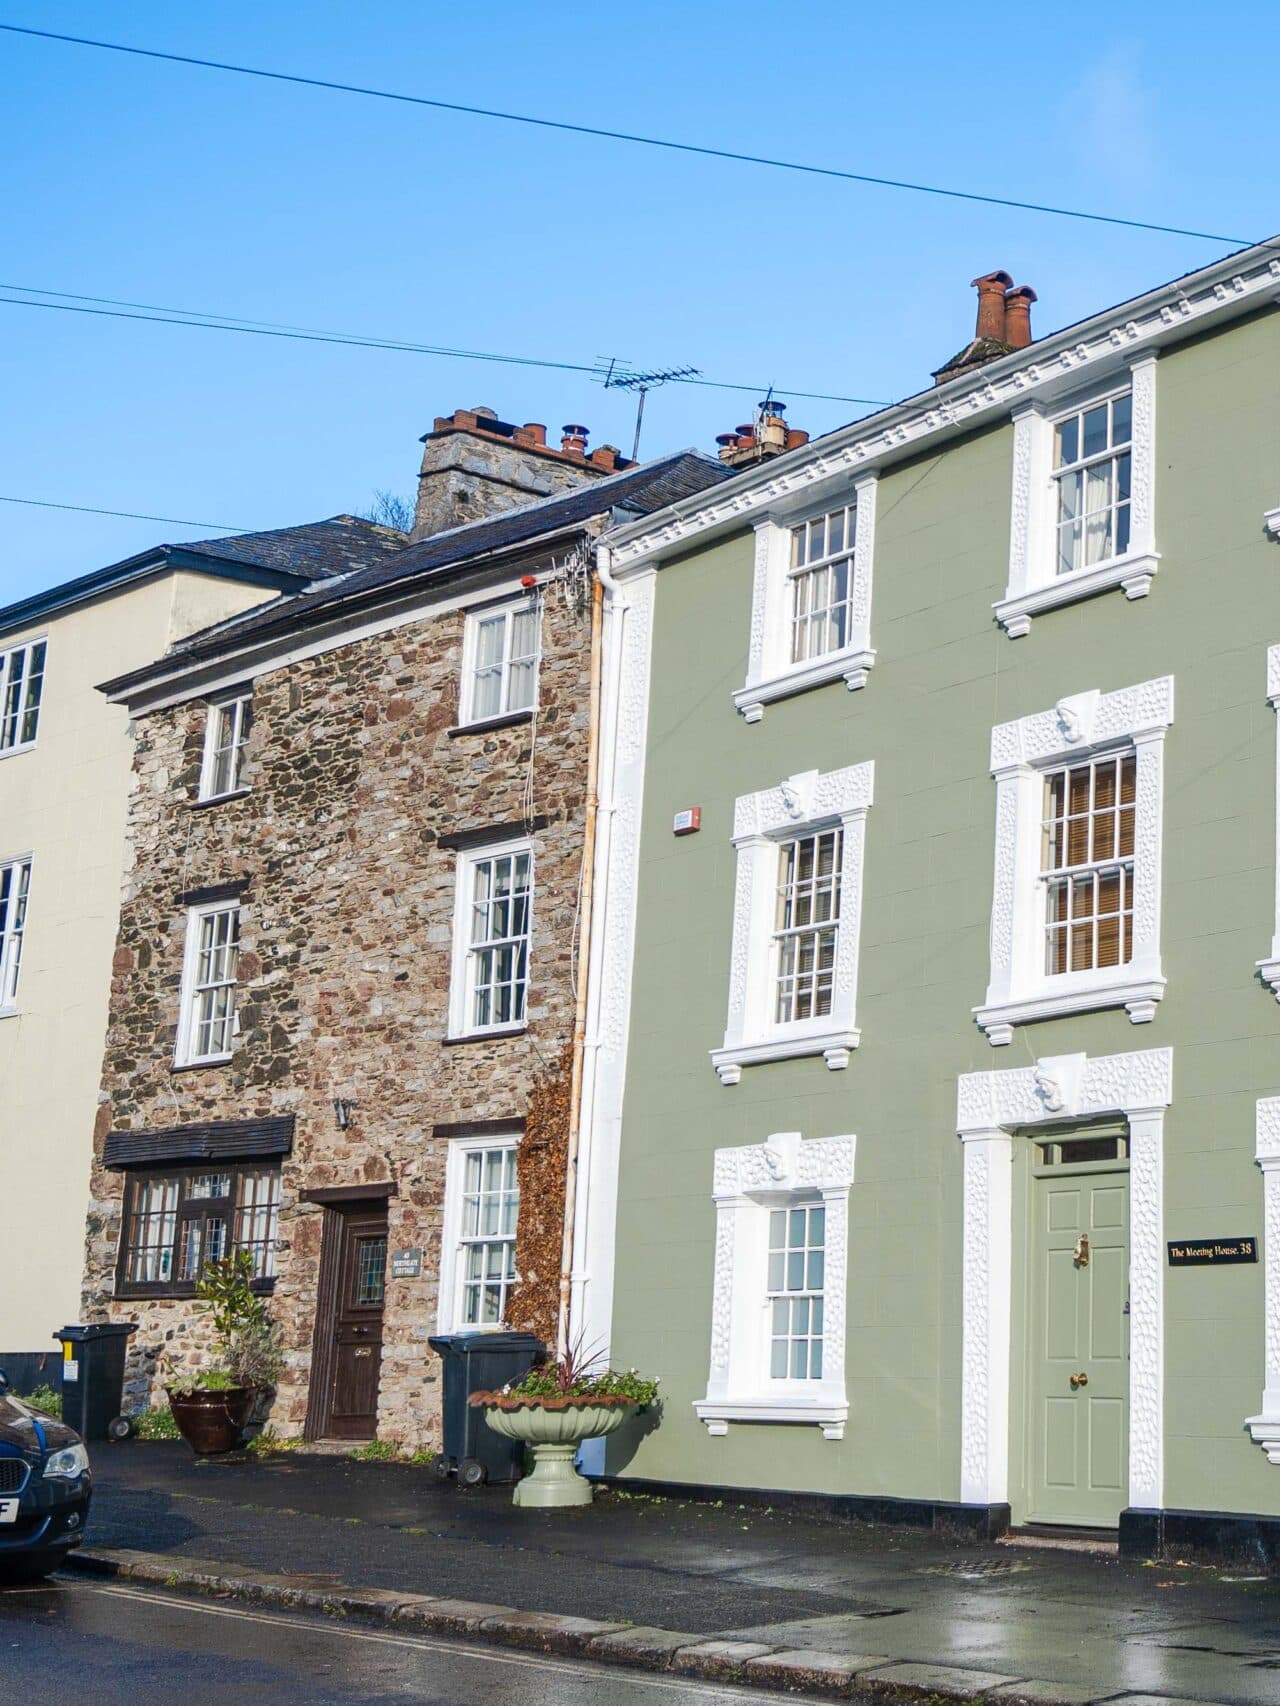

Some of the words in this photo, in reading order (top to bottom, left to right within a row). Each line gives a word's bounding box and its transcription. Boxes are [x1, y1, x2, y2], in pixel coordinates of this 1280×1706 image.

[1171, 1248, 1184, 1257] The
[1186, 1247, 1213, 1258] Meeting
[1240, 1243, 1252, 1254] 38
